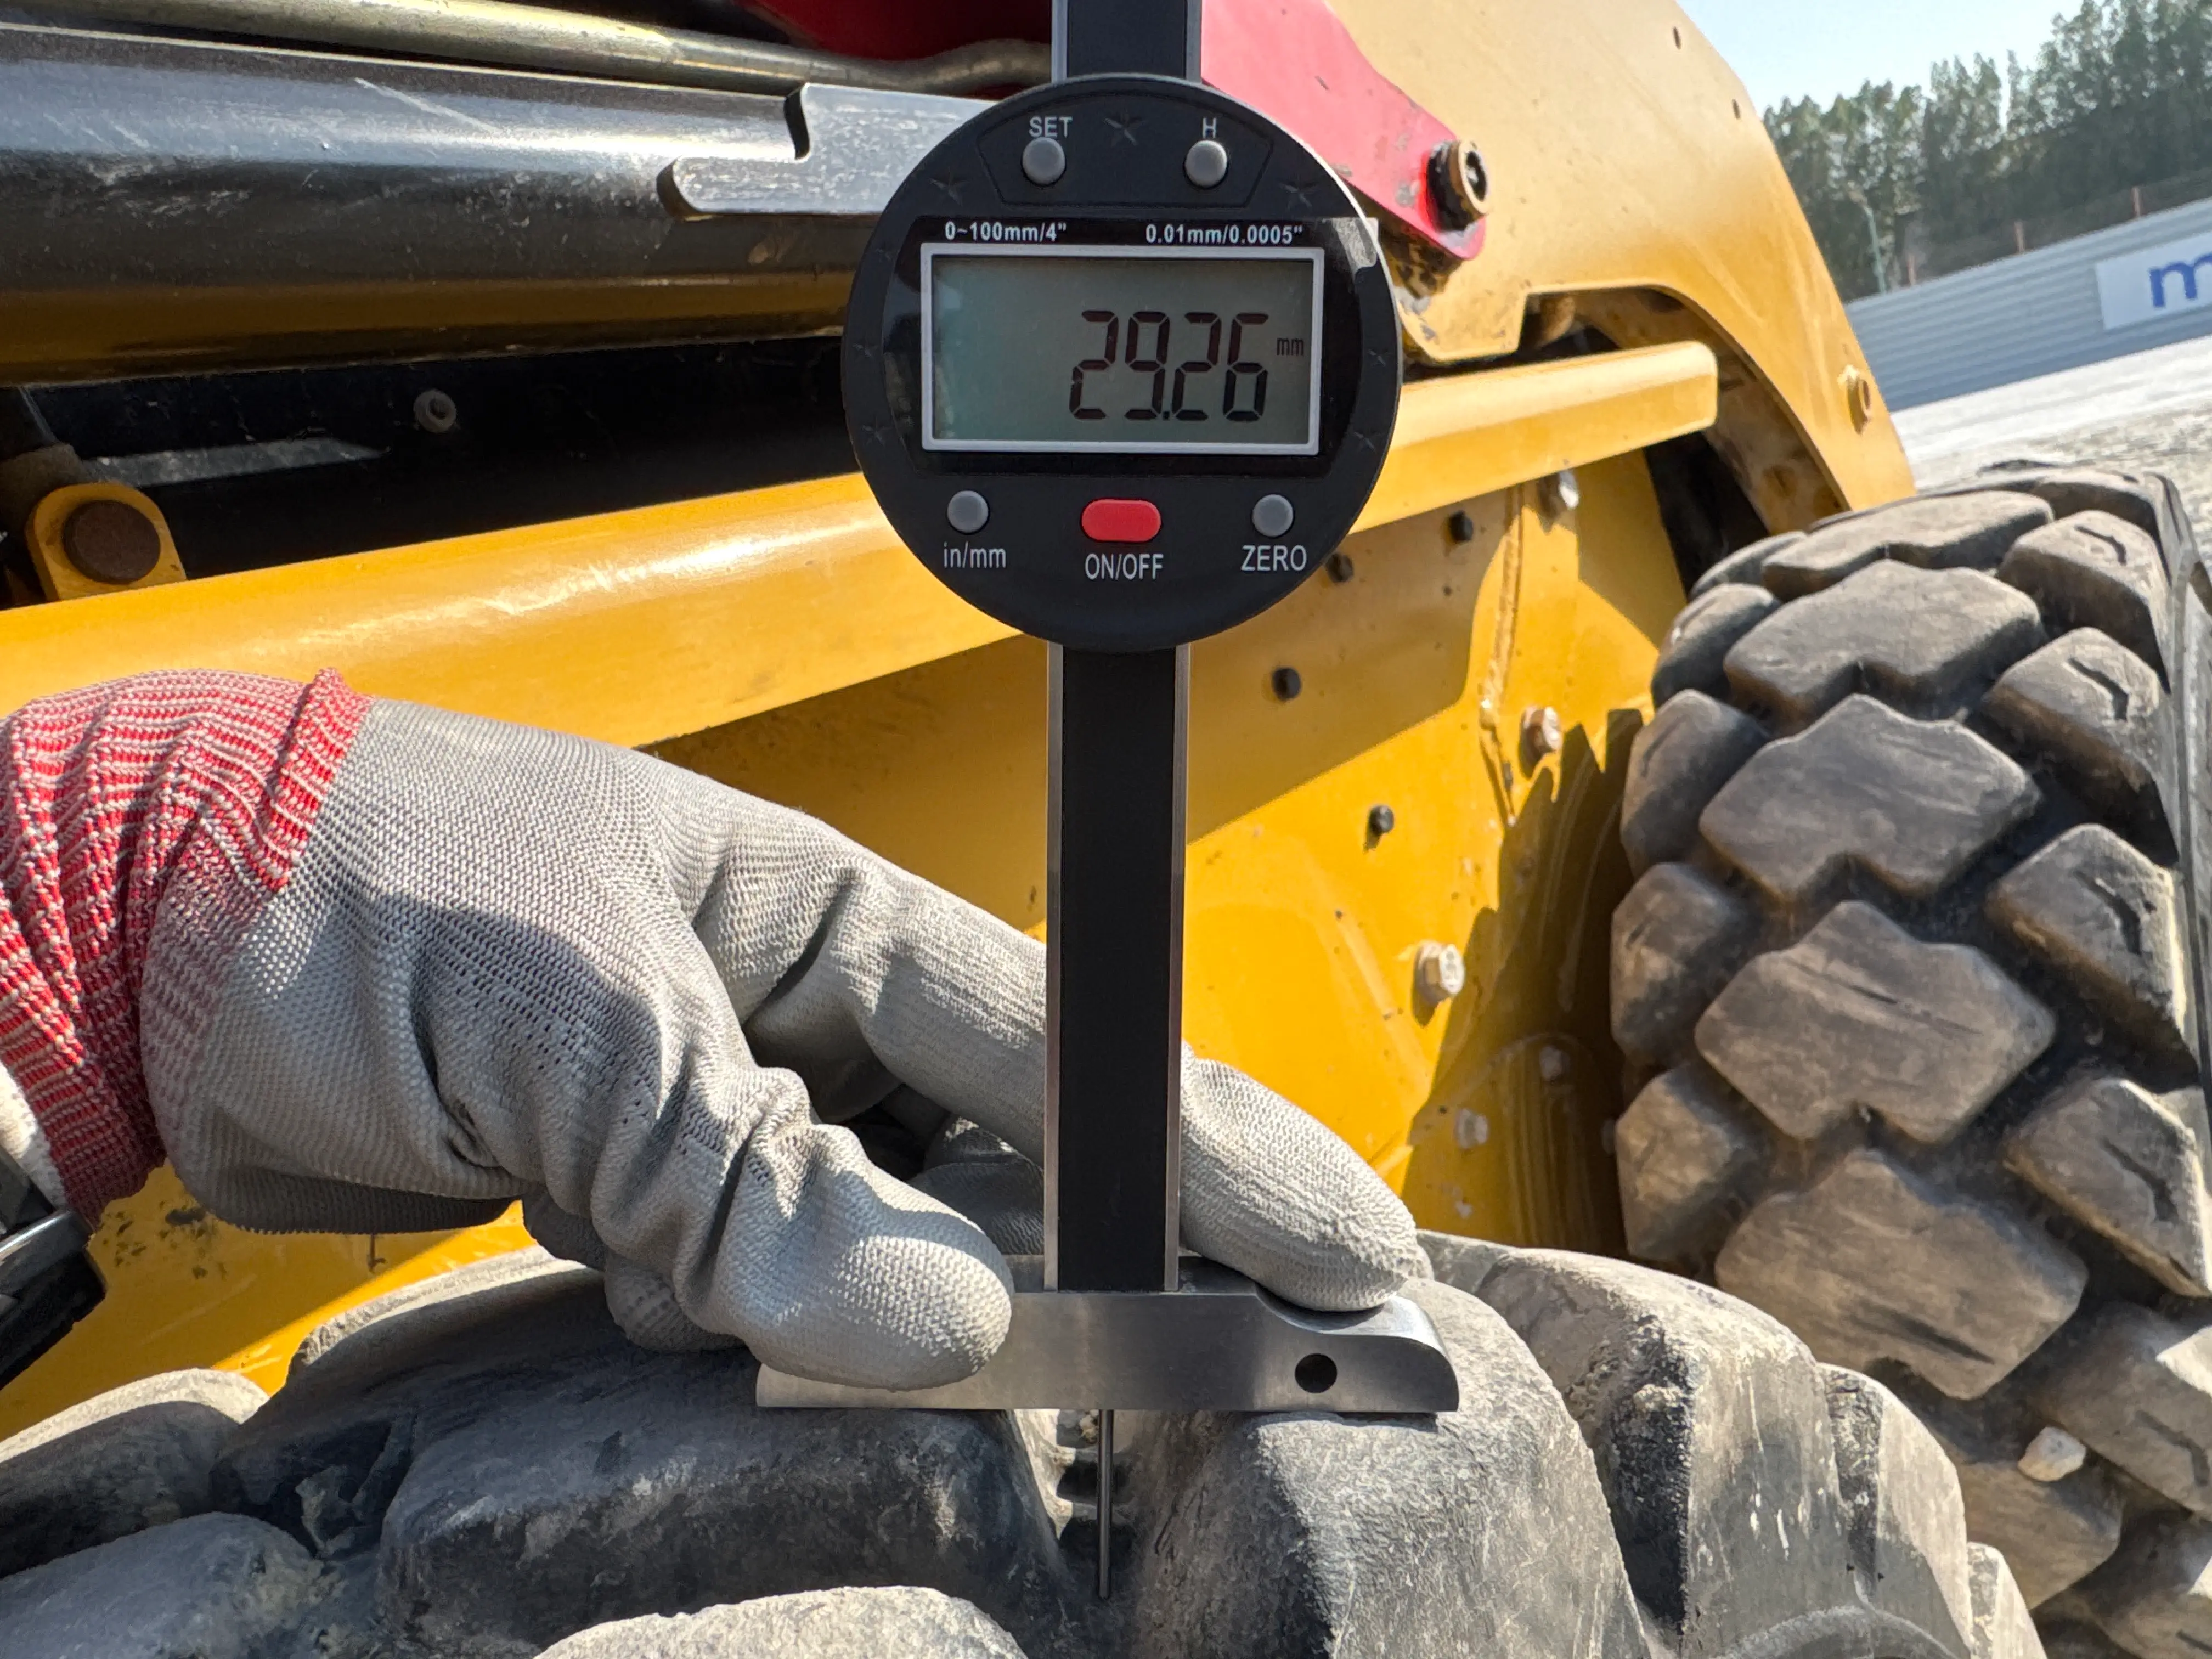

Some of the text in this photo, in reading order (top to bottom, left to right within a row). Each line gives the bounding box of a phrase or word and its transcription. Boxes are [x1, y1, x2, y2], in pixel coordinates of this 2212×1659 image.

[1029, 116, 1073, 138] SET
[1202, 117, 1217, 139] H
[1146, 224, 1302, 245] 0.01mm/0.0005"
[1069, 310, 1305, 422] 29.26 mm
[943, 541, 1007, 569] in/mm
[1085, 553, 1164, 580] ON/OFF
[1240, 544, 1308, 572] ZERO
